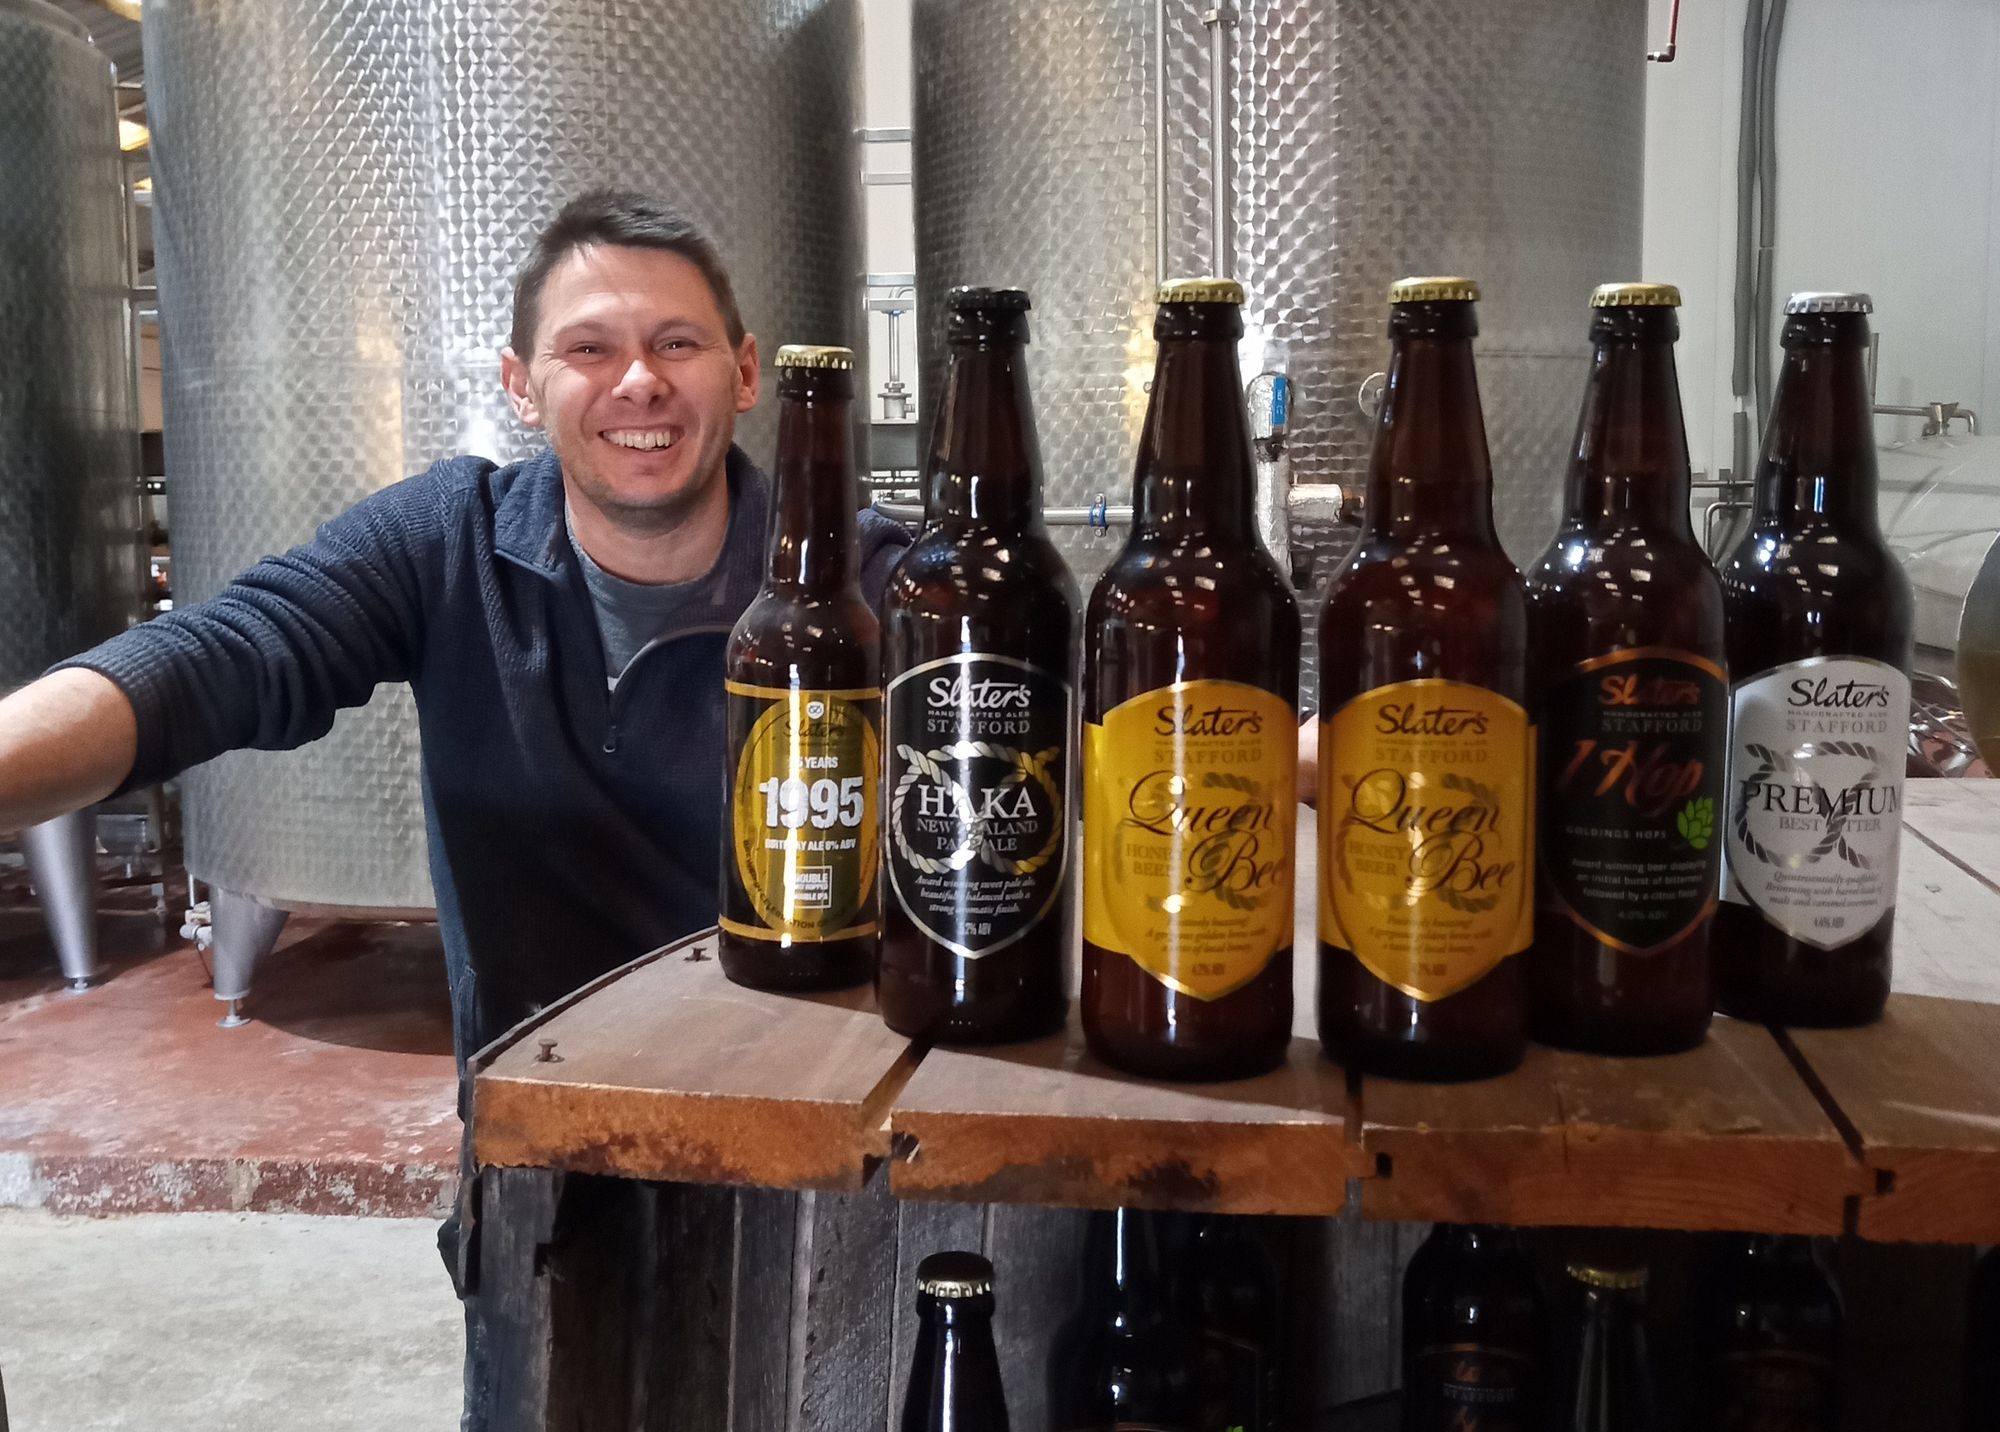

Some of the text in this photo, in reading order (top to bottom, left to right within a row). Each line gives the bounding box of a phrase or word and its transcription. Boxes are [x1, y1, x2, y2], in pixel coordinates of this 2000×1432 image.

[927, 677, 1031, 709] Slater's
[1787, 677, 1890, 708] Slater's
[928, 710, 1002, 718] HANDCAFTED
[1154, 704, 1264, 736] Slater's
[1375, 702, 1489, 736] Slater's
[1601, 718, 1703, 733] STAFFORD
[1785, 718, 1889, 734] STAFFORD
[804, 757, 838, 768] YEARS
[758, 776, 864, 829] 1995
[918, 784, 1038, 819] HAKA
[1121, 769, 1274, 837] Queen
[1348, 768, 1501, 835] Queen
[916, 818, 1039, 836] NEW ALAND
[1565, 825, 1667, 839] GOLDINGS HOPS
[1779, 816, 1882, 833] BEST TTER
[764, 838, 856, 850] BIRTAY ALE 8% ABV
[1184, 829, 1286, 894] Bee
[1405, 830, 1517, 893] Bee
[759, 892, 815, 930] CELEBRTION
